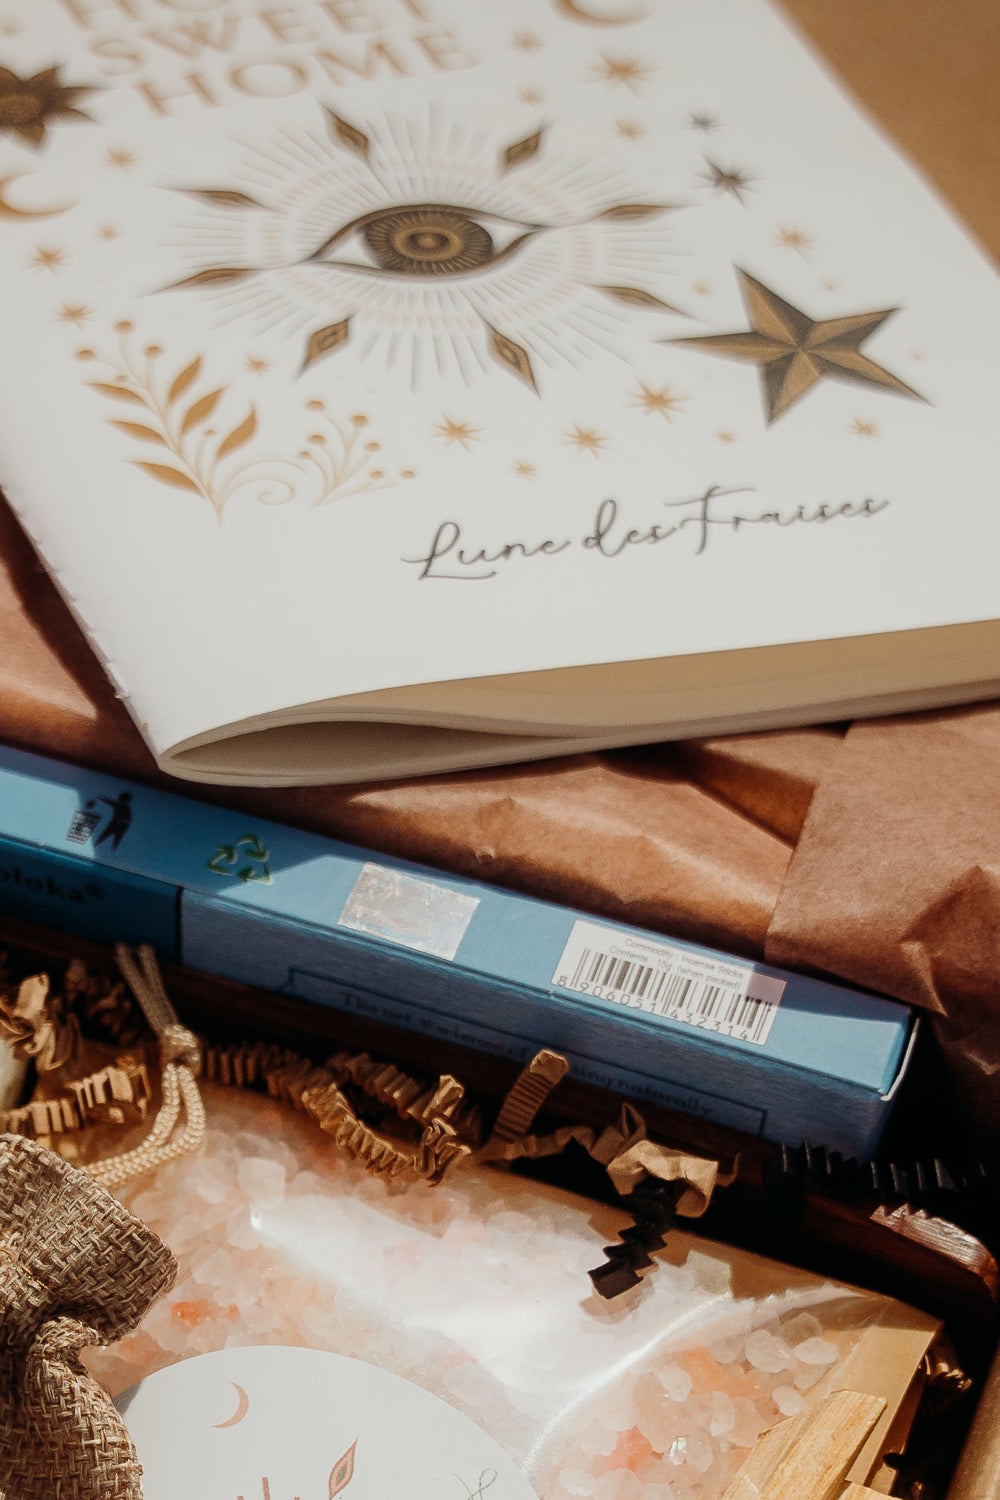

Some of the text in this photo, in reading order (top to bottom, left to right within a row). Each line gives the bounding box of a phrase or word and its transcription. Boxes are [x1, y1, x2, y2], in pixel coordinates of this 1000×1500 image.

[134, 29, 480, 118] HOME
[400, 485, 890, 580] Lune des Fraises
[609, 945, 742, 990] Contents 15g (when packed)
[625, 938, 743, 979] Commodity Incense Sticks
